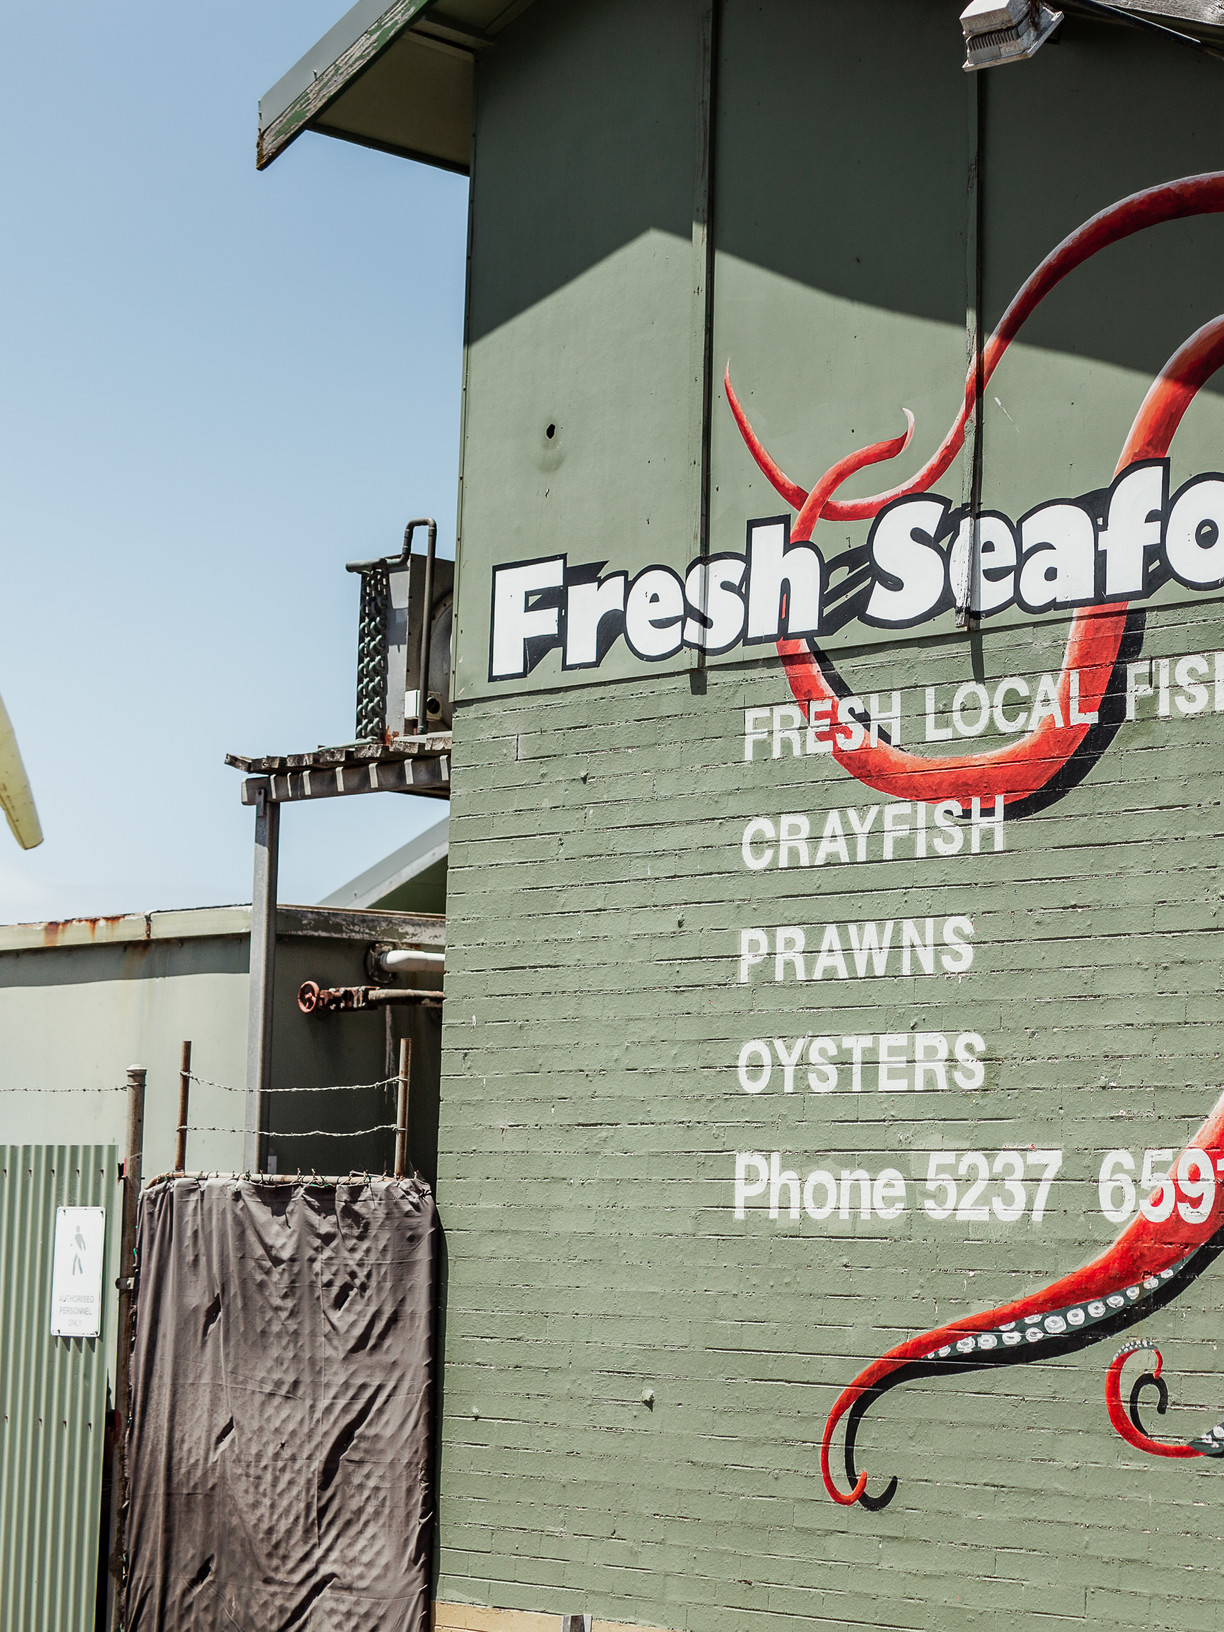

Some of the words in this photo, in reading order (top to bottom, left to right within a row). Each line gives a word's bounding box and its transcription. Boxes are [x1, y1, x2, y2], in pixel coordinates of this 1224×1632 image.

[490, 516, 822, 681] Fresh
[743, 693, 900, 762] FRESH
[924, 670, 1099, 741] LOCAL
[741, 795, 1006, 870] CRAYFISH
[738, 915, 975, 984] PRAWNS
[736, 1031, 987, 1094] OYSTERS
[733, 1150, 906, 1221] Phone
[923, 1148, 1063, 1223] 5237
